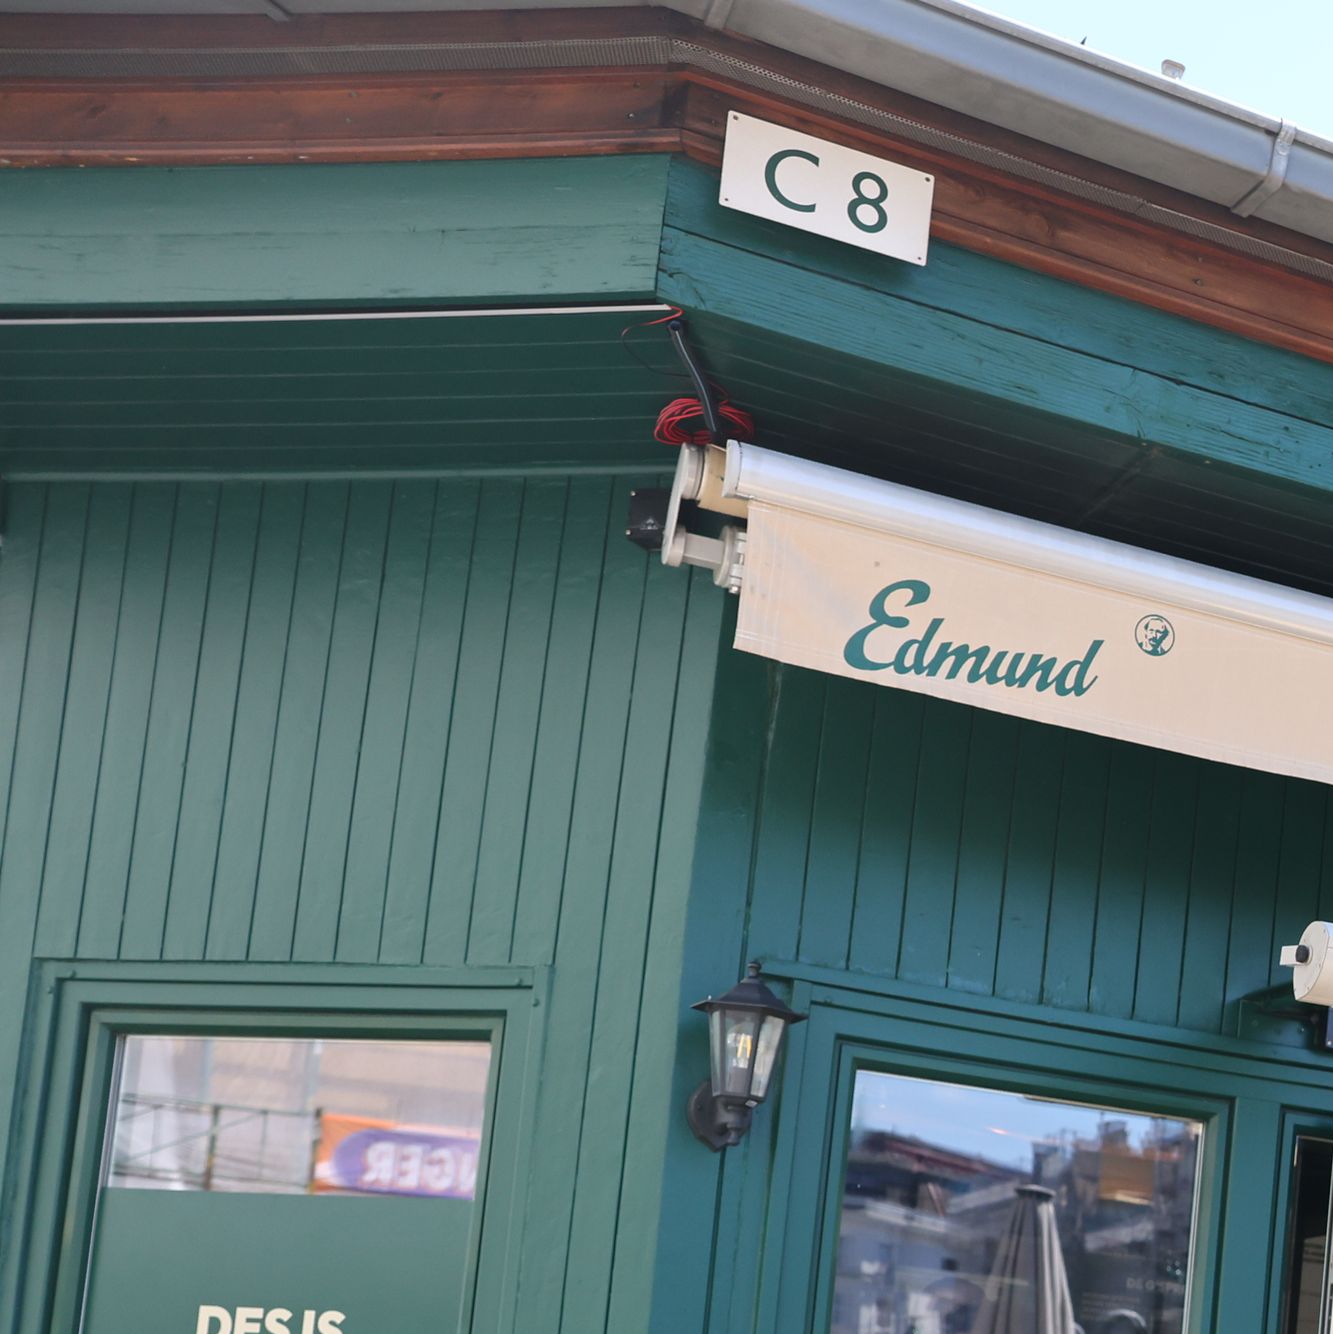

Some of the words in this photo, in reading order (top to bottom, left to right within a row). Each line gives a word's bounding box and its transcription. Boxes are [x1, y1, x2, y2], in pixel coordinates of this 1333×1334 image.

[764, 149, 820, 212] C
[846, 171, 889, 234] 8
[842, 579, 1104, 697] Edmund
